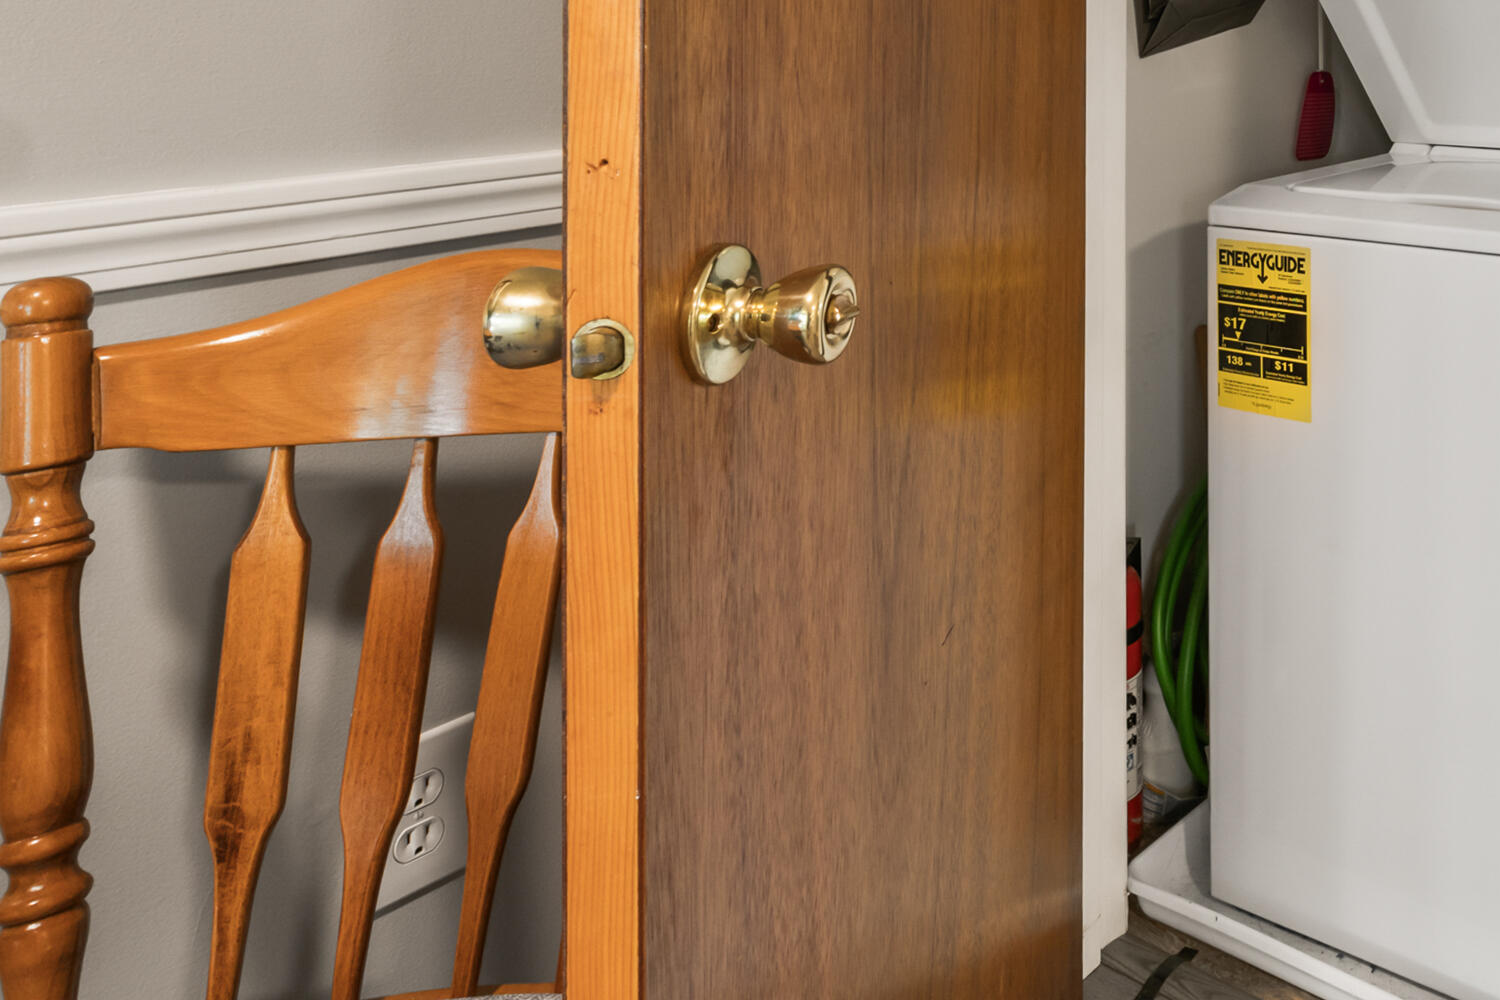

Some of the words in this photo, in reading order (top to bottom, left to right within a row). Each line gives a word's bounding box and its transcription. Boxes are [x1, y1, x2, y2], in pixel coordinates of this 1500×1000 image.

[1219, 249, 1306, 275] ENERGYGUIDE
[1224, 317, 1246, 330] $17
[1226, 355, 1243, 366] 138
[1275, 361, 1293, 372] $11
